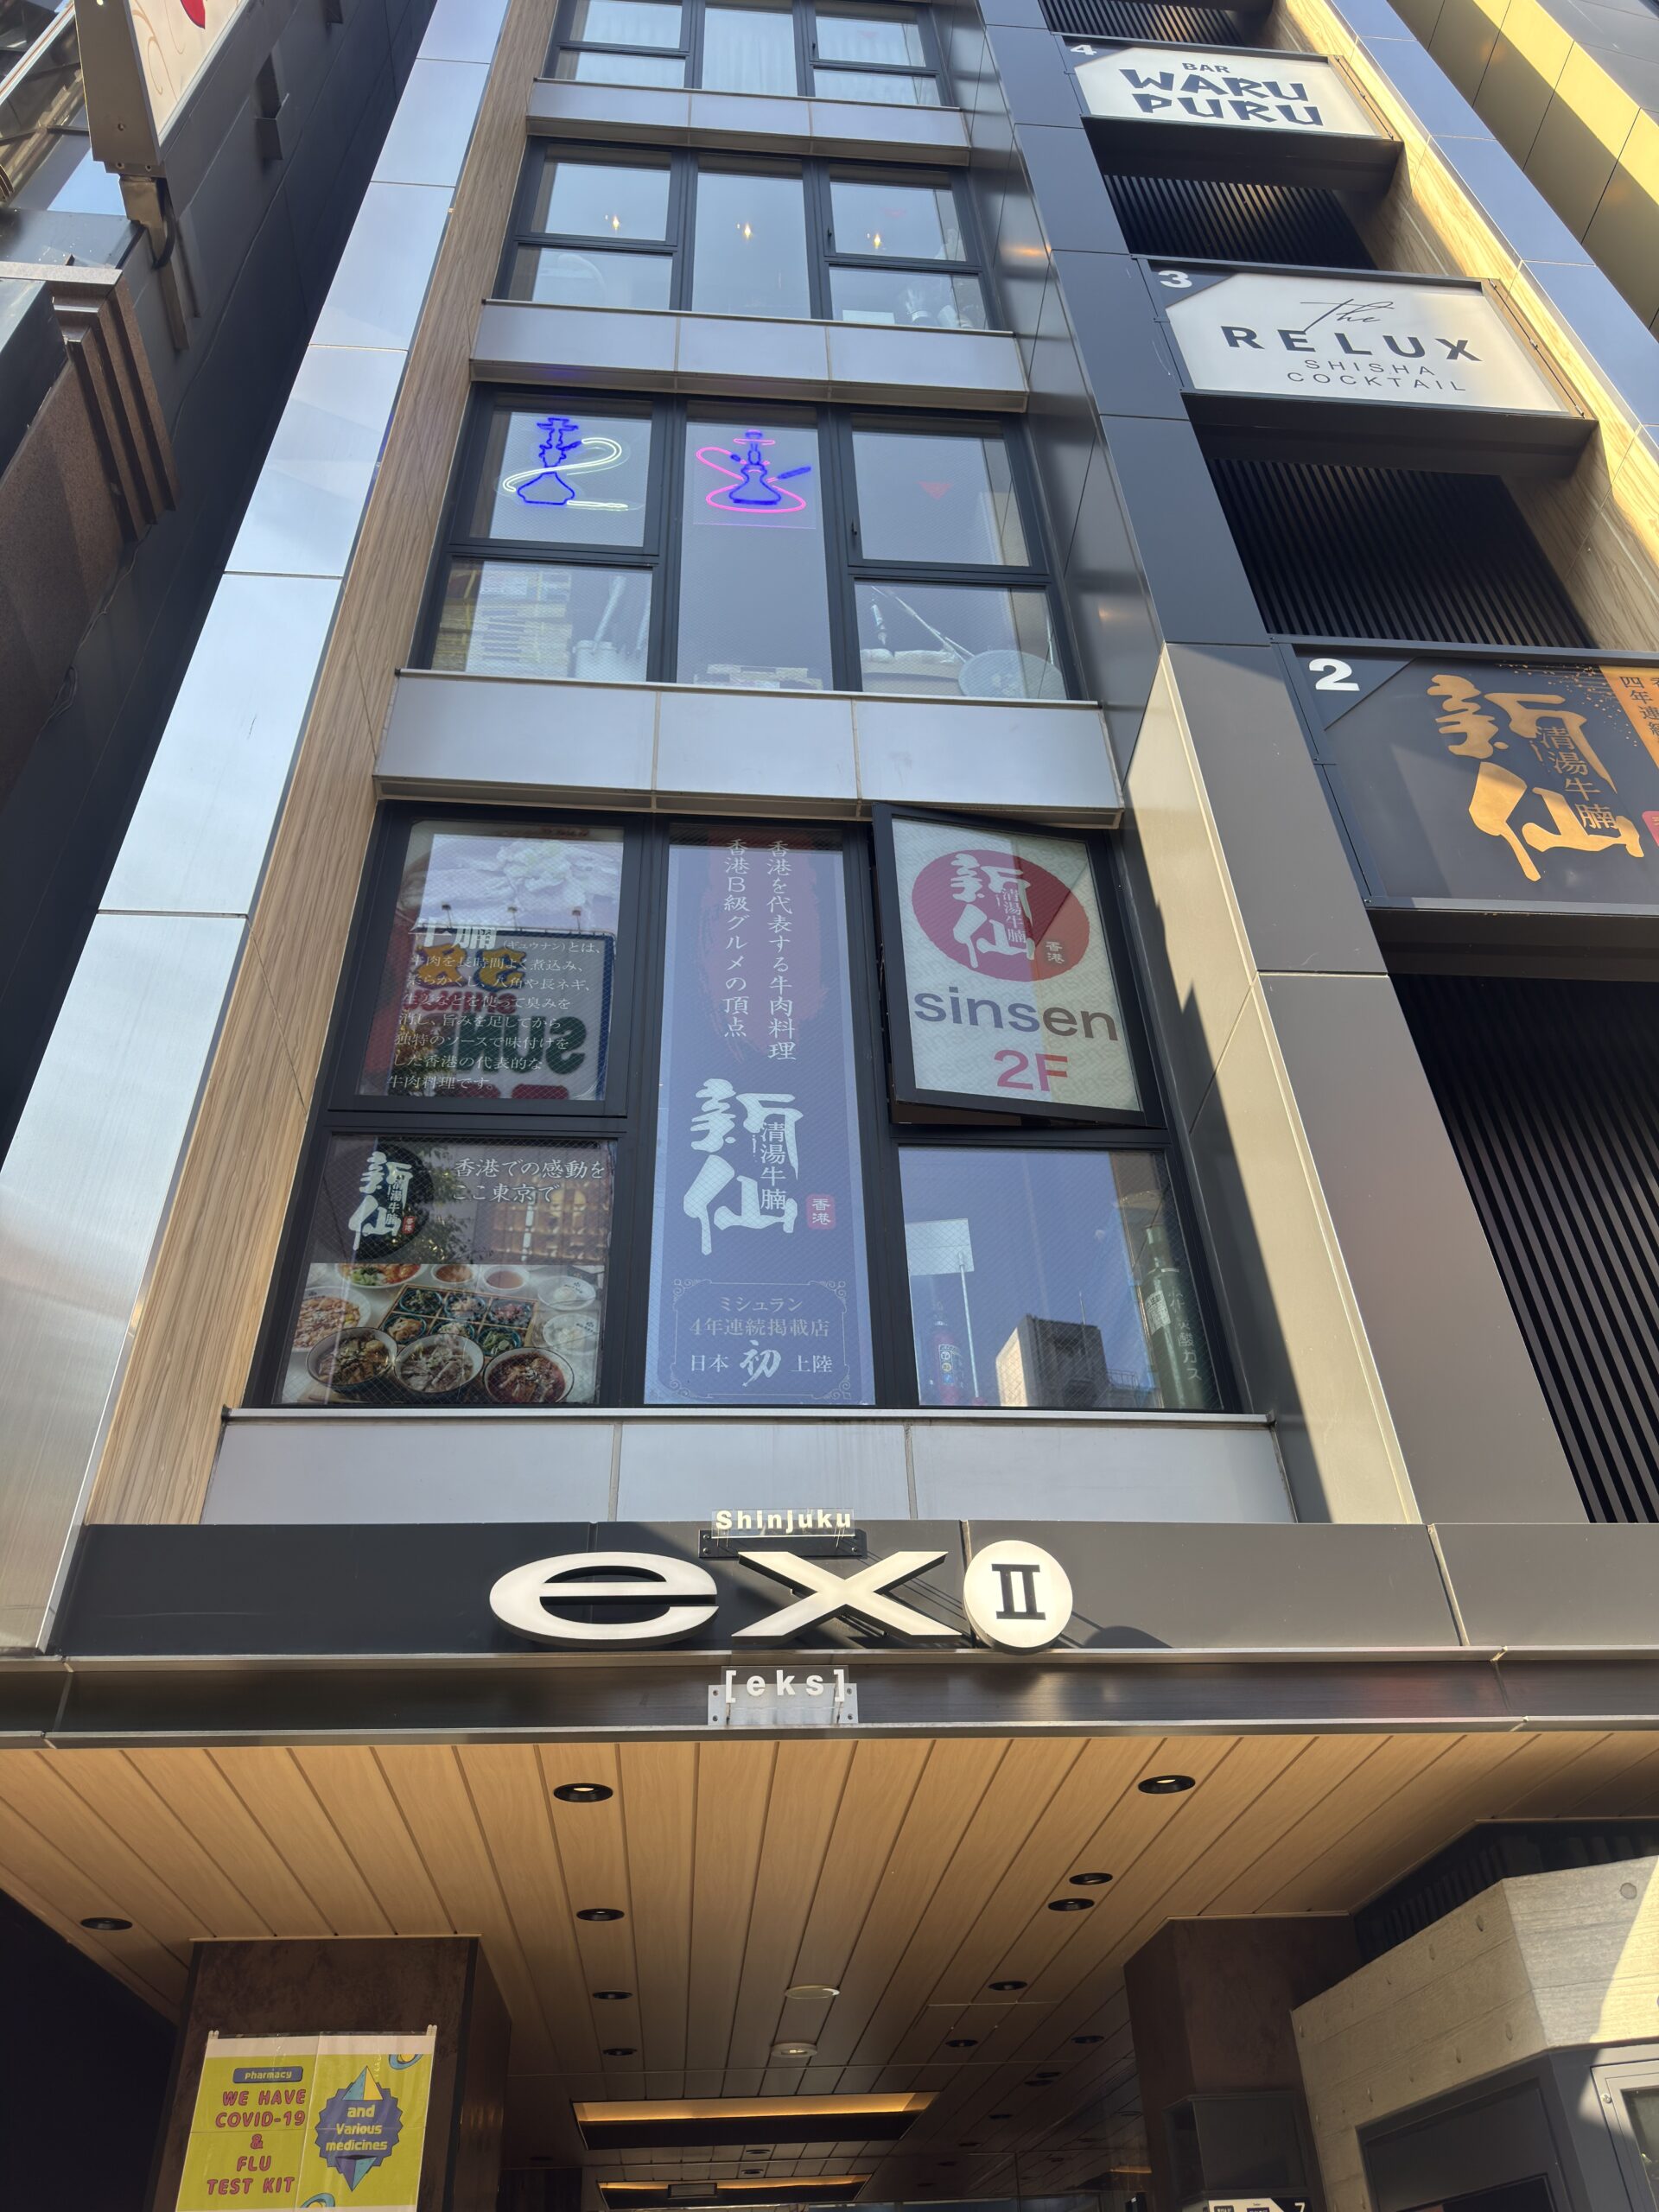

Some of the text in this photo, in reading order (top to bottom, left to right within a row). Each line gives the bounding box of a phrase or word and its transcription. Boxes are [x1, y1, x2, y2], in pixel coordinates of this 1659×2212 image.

[1070, 44, 1097, 56] 4
[1182, 62, 1231, 74] BAR
[1118, 68, 1307, 102] WARU
[1135, 93, 1324, 126] PURU
[1157, 270, 1193, 289] 3
[1220, 326, 1483, 362] RELUX
[1305, 359, 1436, 376] SHISHA
[1287, 372, 1466, 391] COCKTAIL
[1309, 658, 1360, 691] 2
[722, 838, 750, 1038] 香港B級グルメの頂点
[766, 840, 797, 1060] 香港を代表する牛肉料理
[1046, 941, 1065, 964] 香港
[914, 986, 1119, 1041] sinsen
[994, 1049, 1068, 1091] 2F
[454, 1157, 605, 1179] 香港での感動を
[760, 1122, 787, 1211] 清湯牛腩
[452, 1184, 560, 1204] ここ東京で
[811, 1198, 830, 1225] 香港
[719, 1296, 804, 1313] ミシュラン
[690, 1317, 830, 1338] 4年連続掲載店
[691, 1355, 729, 1372] 日本
[791, 1355, 833, 1372] 上陸
[715, 1510, 852, 1530] Shinjuku
[245, 2069, 292, 2082] pharmacy
[222, 2089, 307, 2106] WE HAVE
[215, 2110, 306, 2128] COVID-19
[347, 2105, 376, 2118] and
[336, 2123, 383, 2135] Various
[250, 2133, 263, 2150] &
[326, 2139, 388, 2152] medicines
[236, 2156, 272, 2171] FLU
[207, 2177, 295, 2196] TEST KIT
